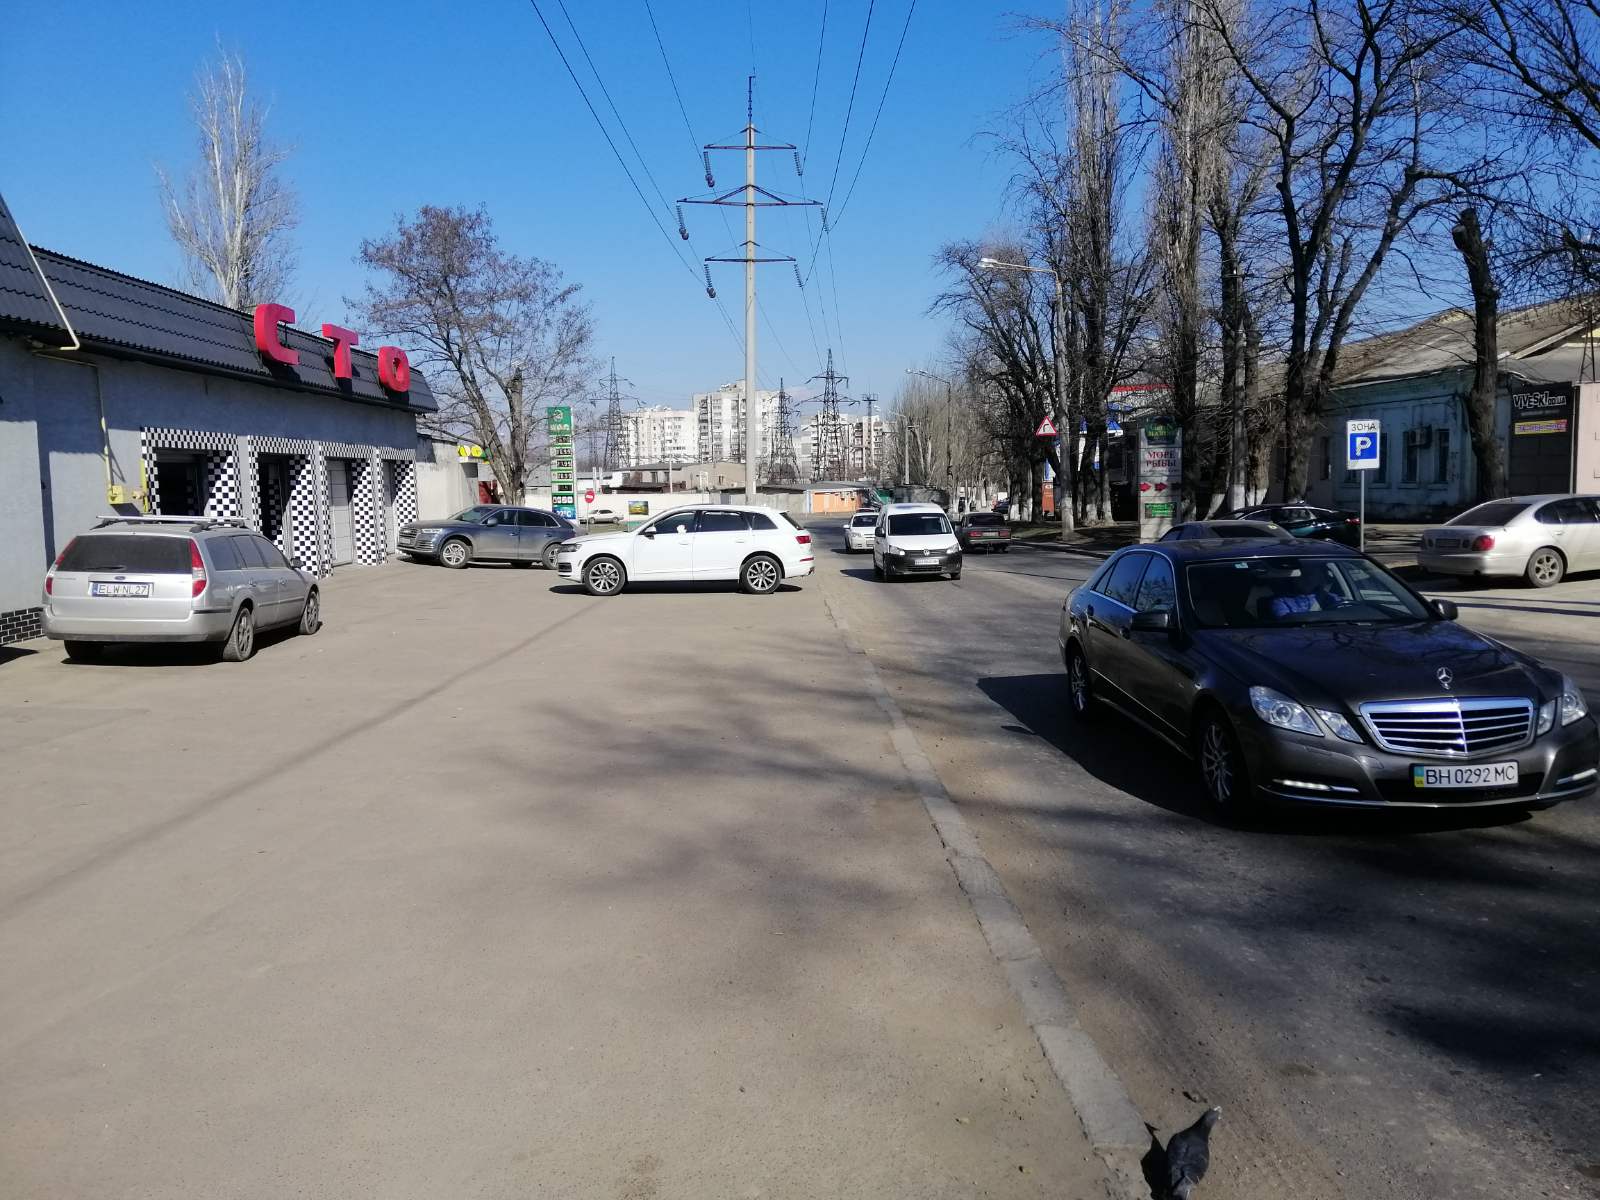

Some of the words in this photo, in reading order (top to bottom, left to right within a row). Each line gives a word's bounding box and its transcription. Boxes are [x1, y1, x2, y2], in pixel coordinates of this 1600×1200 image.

[254, 303, 410, 392] СТО
[1512, 391, 1550, 409] VIVESKI
[1351, 423, 1377, 432] ЗОНА
[1147, 451, 1176, 459] МОРЕ
[1355, 436, 1372, 457] P
[1146, 460, 1177, 468] РЫБЫ
[1425, 769, 1451, 785] BH
[1454, 767, 1491, 784] 0292
[1494, 765, 1516, 782] MC
